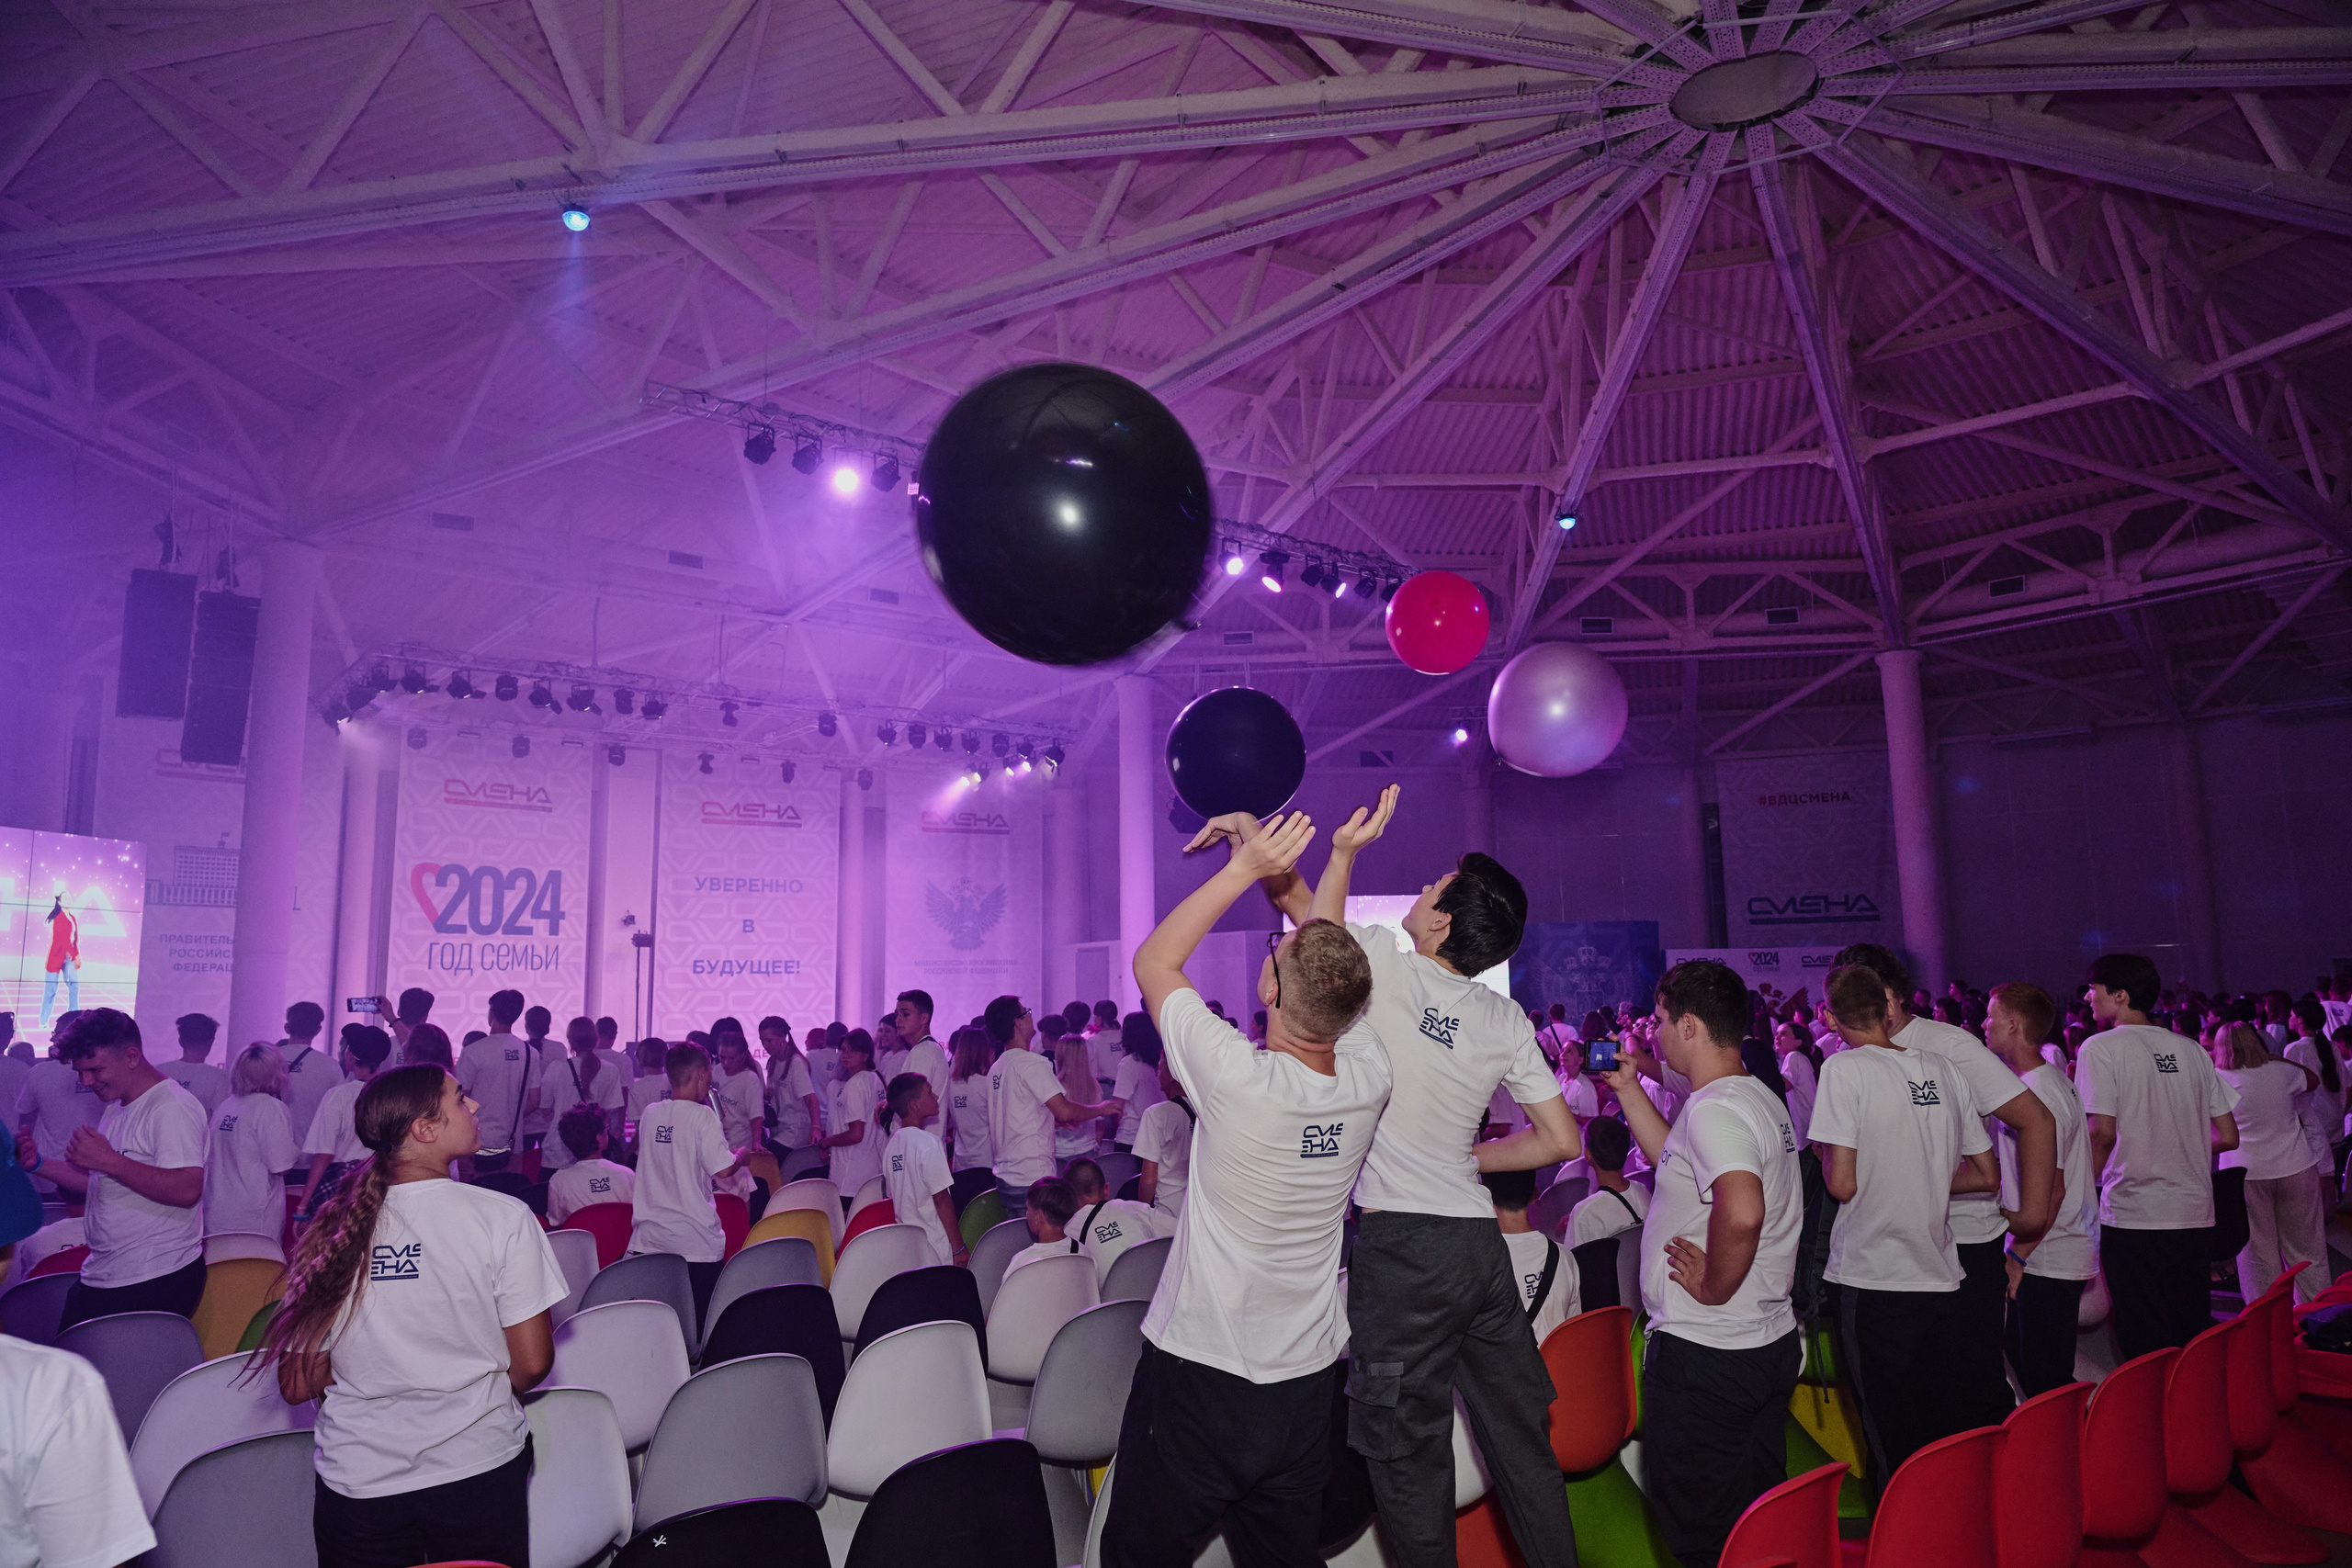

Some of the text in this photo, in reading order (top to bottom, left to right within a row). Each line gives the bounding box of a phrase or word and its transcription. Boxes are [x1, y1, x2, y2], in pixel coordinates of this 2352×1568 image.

[1758, 792, 1851, 807] #ВДЦСМЕНА
[695, 876, 804, 894] УВЕРЕННО
[433, 863, 566, 936] 2024
[742, 919, 755, 934] В
[427, 942, 473, 976] ГОД
[1753, 952, 1780, 965] 2024
[693, 960, 801, 976] БУДУЩЕЕ!
